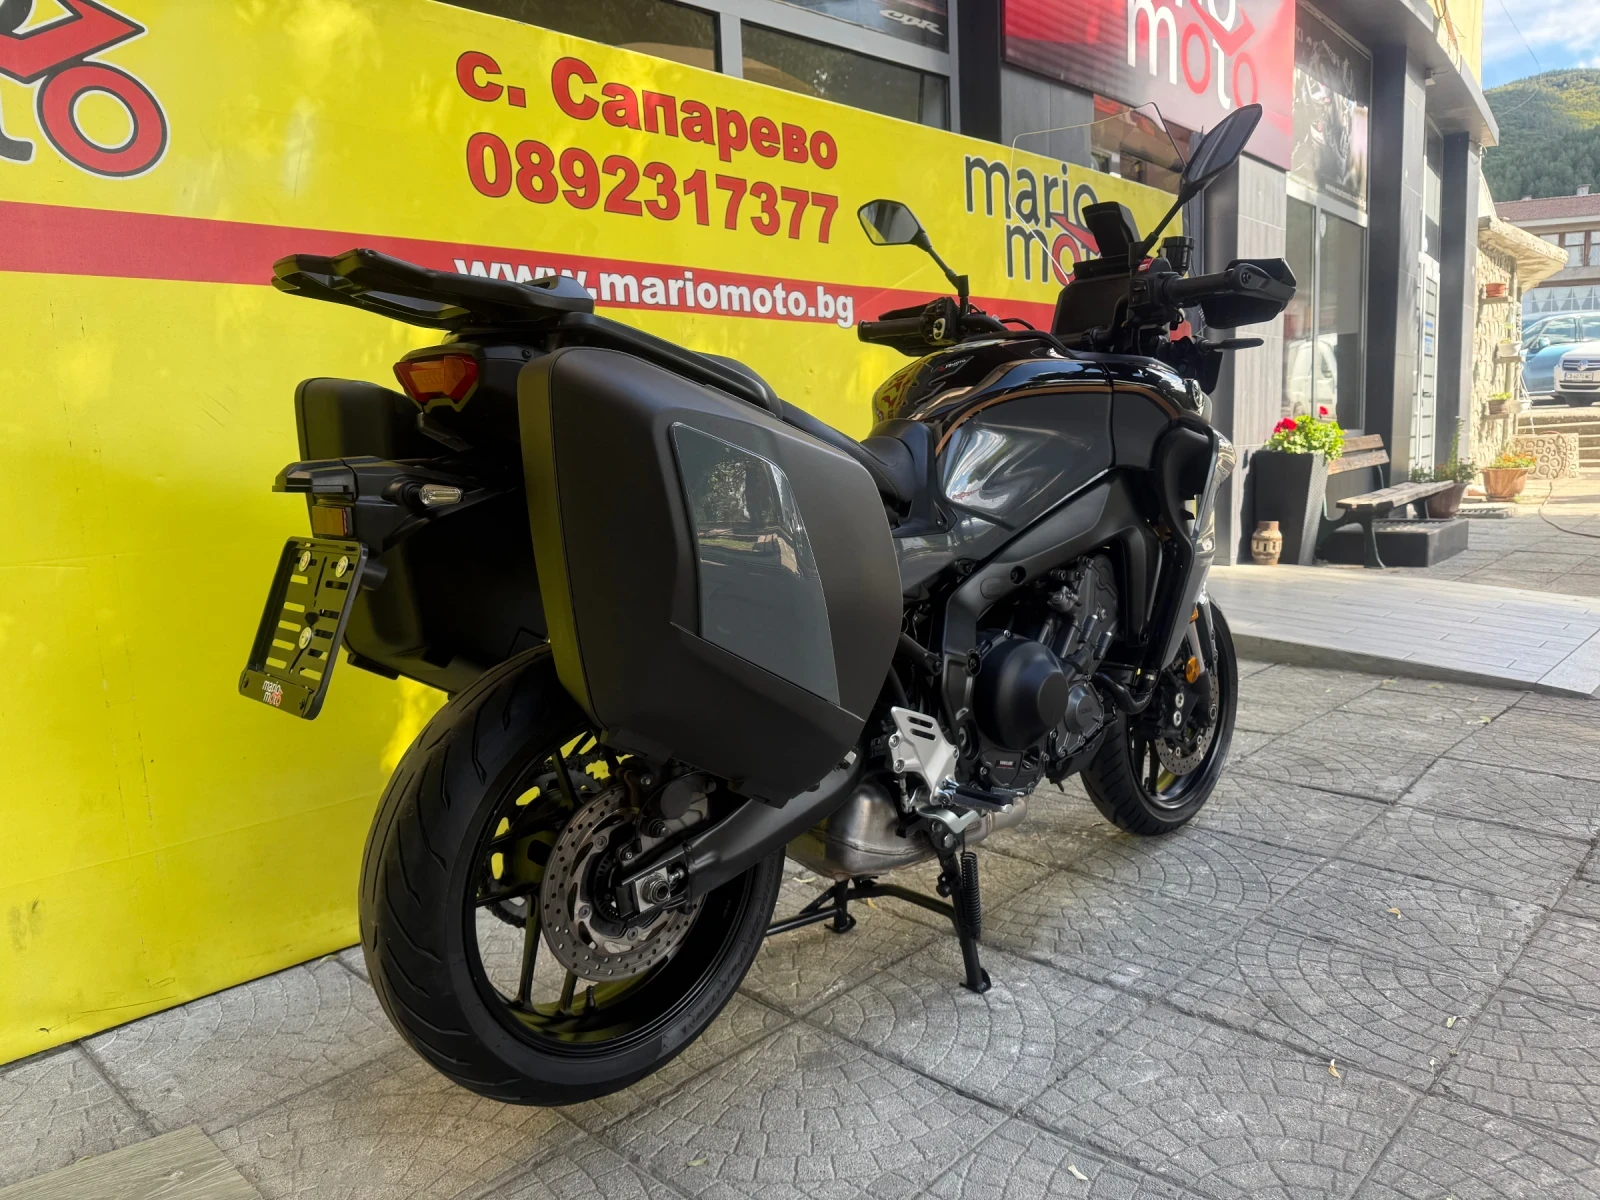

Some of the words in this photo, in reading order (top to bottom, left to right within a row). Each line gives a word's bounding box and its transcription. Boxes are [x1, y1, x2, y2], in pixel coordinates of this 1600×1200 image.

[456, 51, 526, 108] с.
[551, 57, 838, 169] Сапарево
[466, 132, 838, 243] 0892317377
[964, 155, 1098, 229] mario
[261, 680, 281, 693] mario
[262, 691, 282, 707] moto
